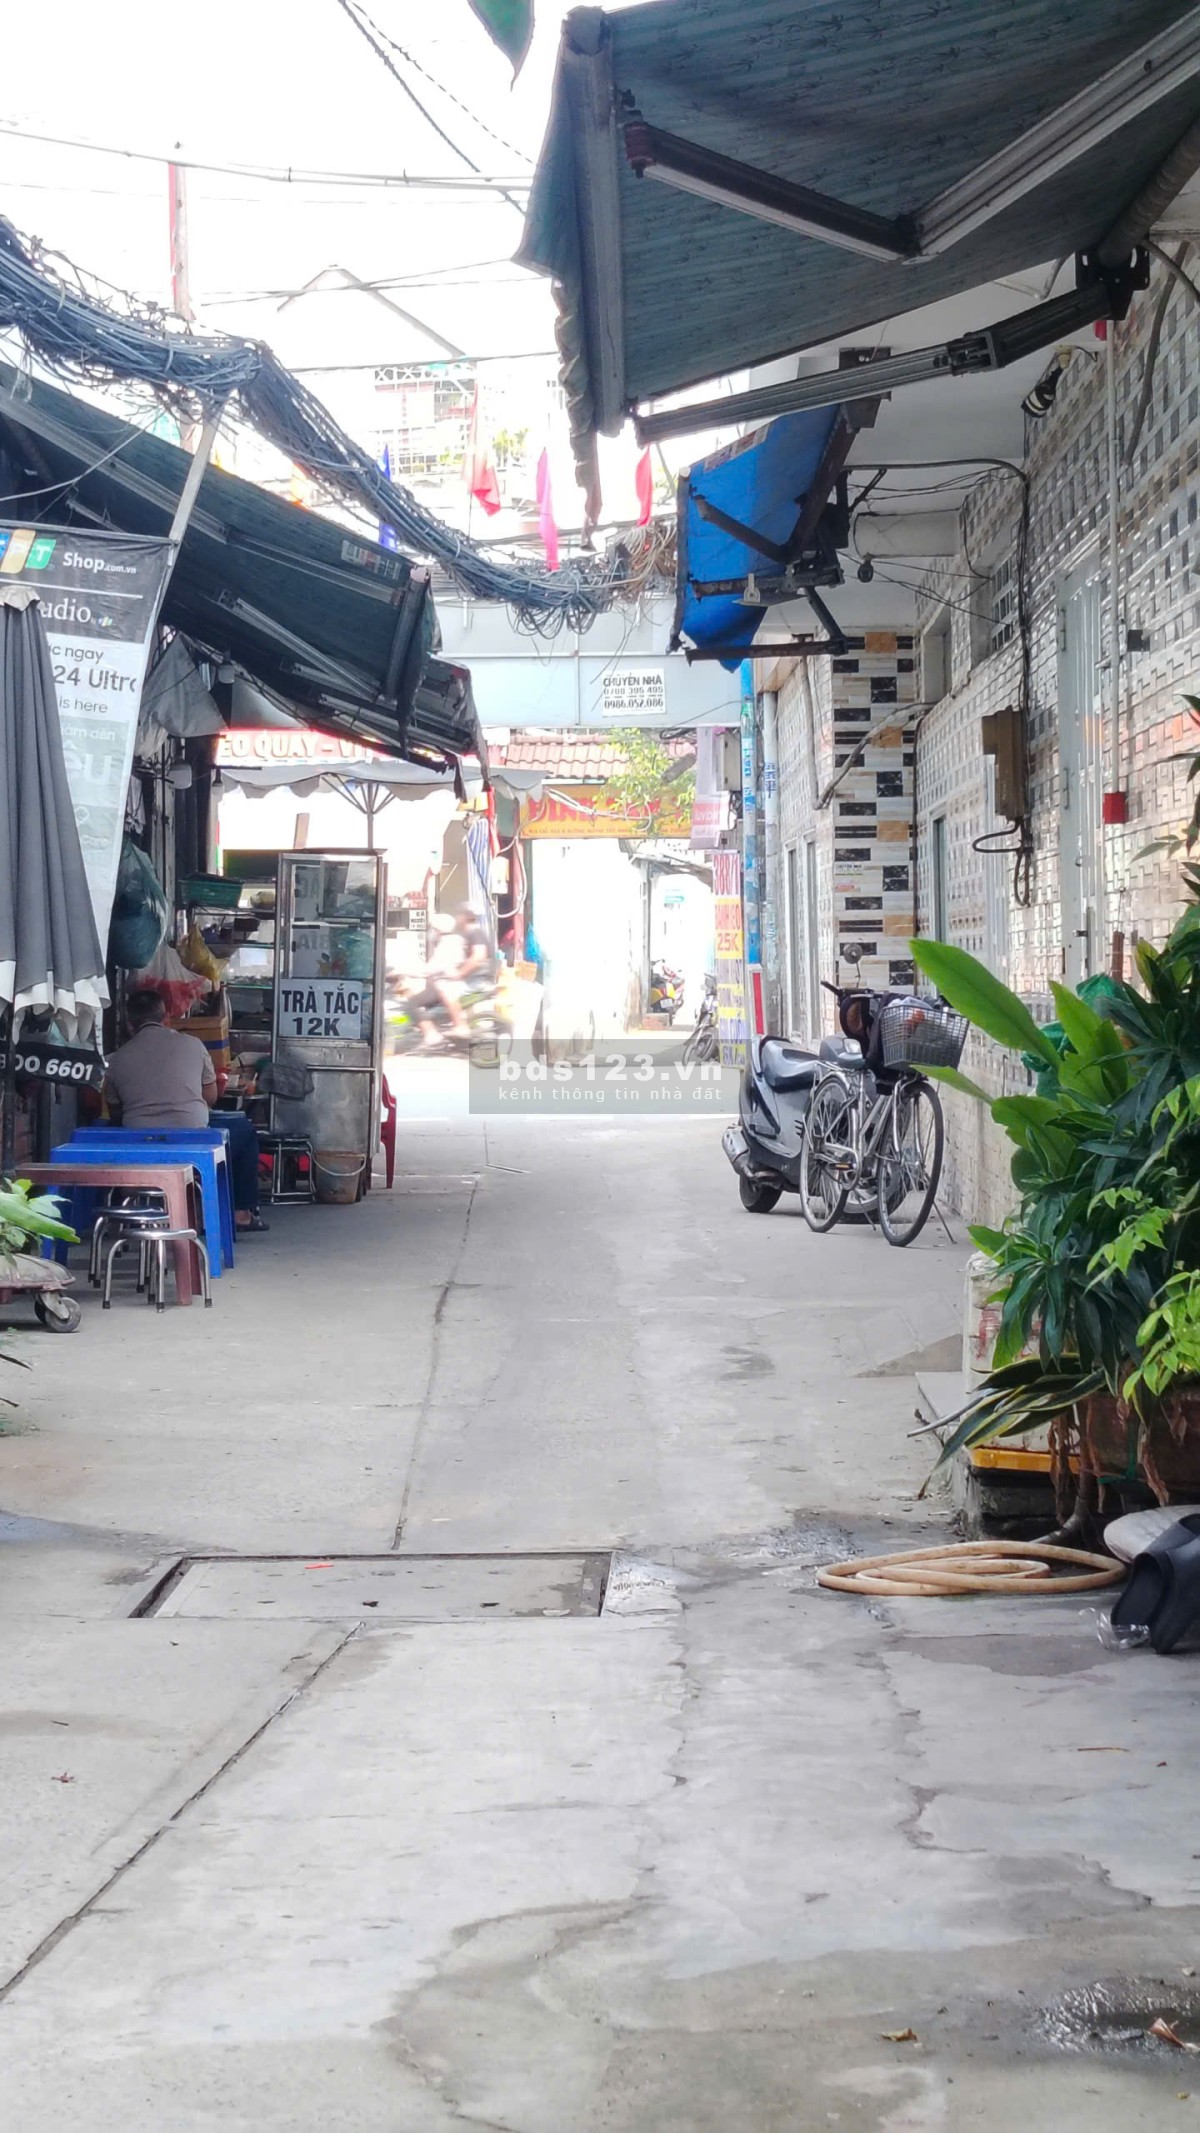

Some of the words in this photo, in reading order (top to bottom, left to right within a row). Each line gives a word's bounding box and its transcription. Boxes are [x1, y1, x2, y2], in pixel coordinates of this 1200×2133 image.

[40, 598, 91, 623] udio
[64, 646, 104, 664] ngay
[54, 664, 81, 687] 24
[74, 698, 109, 714] here
[281, 985, 318, 1014] TRÀ
[323, 983, 359, 1015] TẮC
[292, 1017, 341, 1036] 12K
[45, 1058, 94, 1081] 6601
